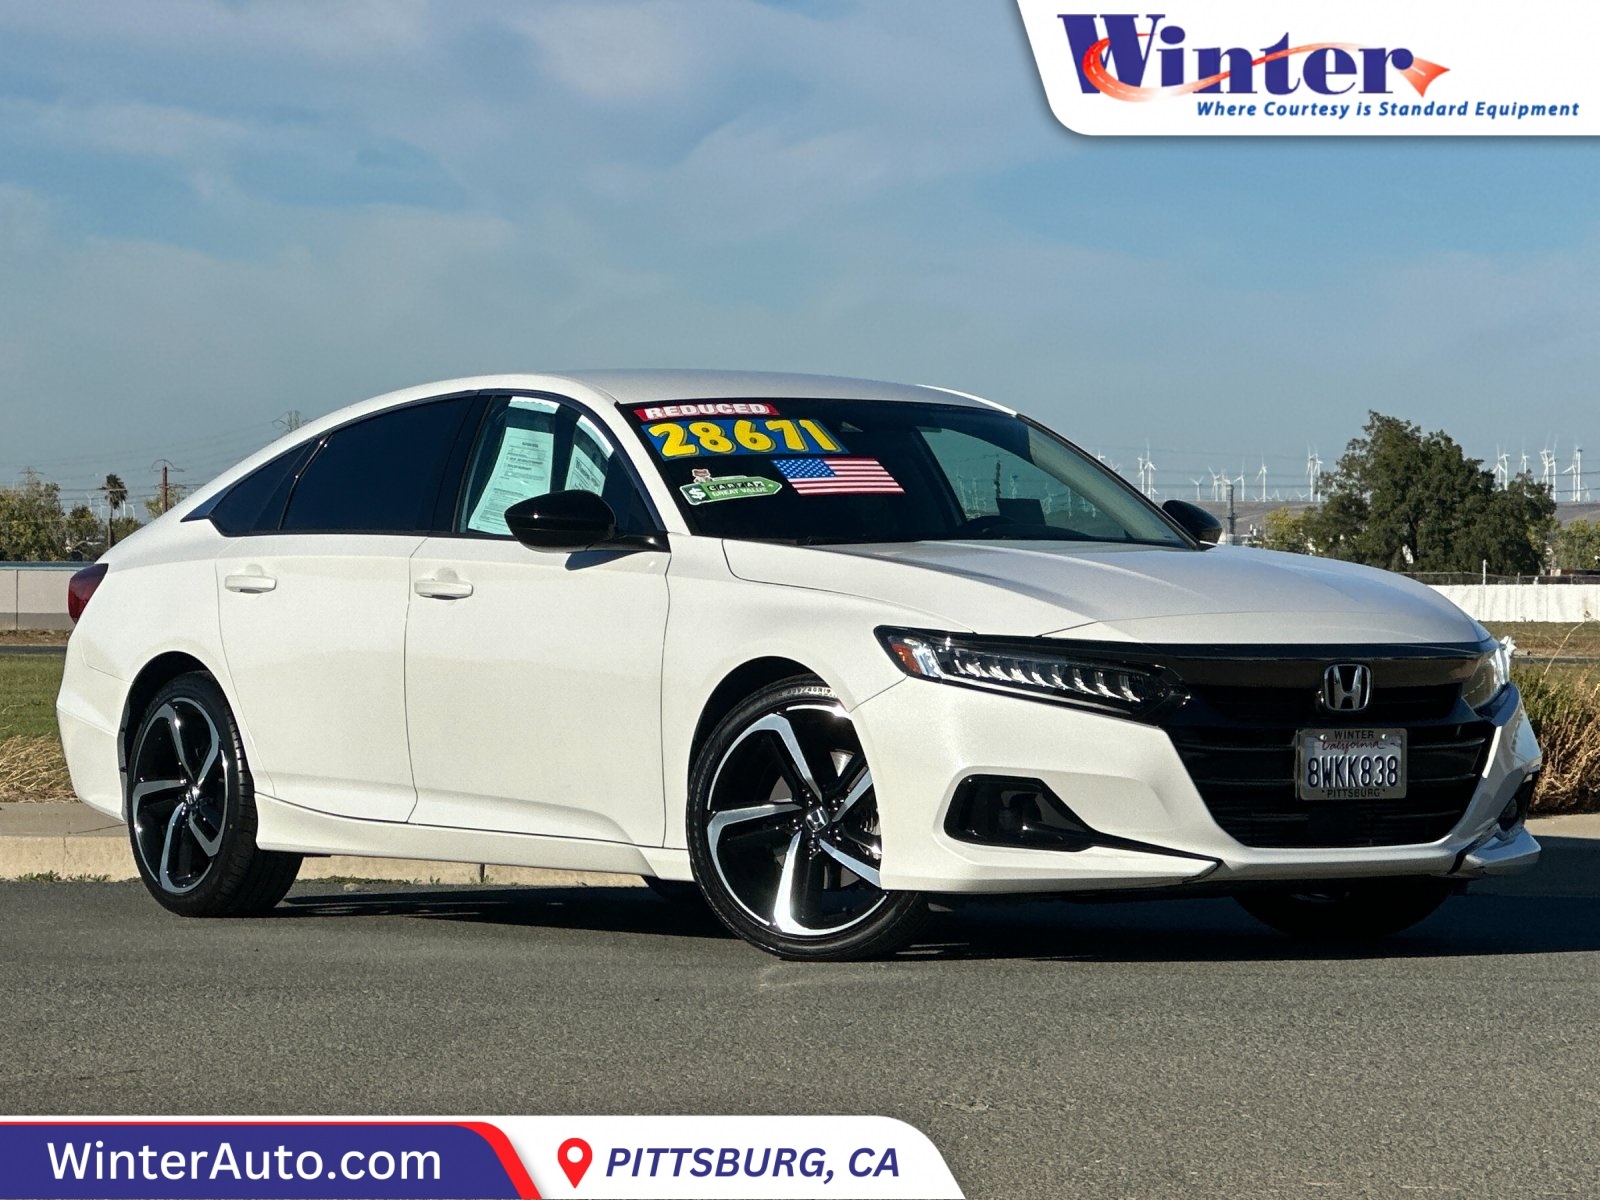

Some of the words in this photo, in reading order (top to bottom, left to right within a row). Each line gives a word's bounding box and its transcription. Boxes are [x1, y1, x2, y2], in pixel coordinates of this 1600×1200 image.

[644, 403, 770, 419] REDUCED
[648, 420, 840, 457] 28671
[1334, 730, 1375, 740] WINTER
[1322, 740, 1385, 755] California
[1307, 754, 1399, 788] 8WKK838
[1327, 788, 1380, 798] PITTSBURG
